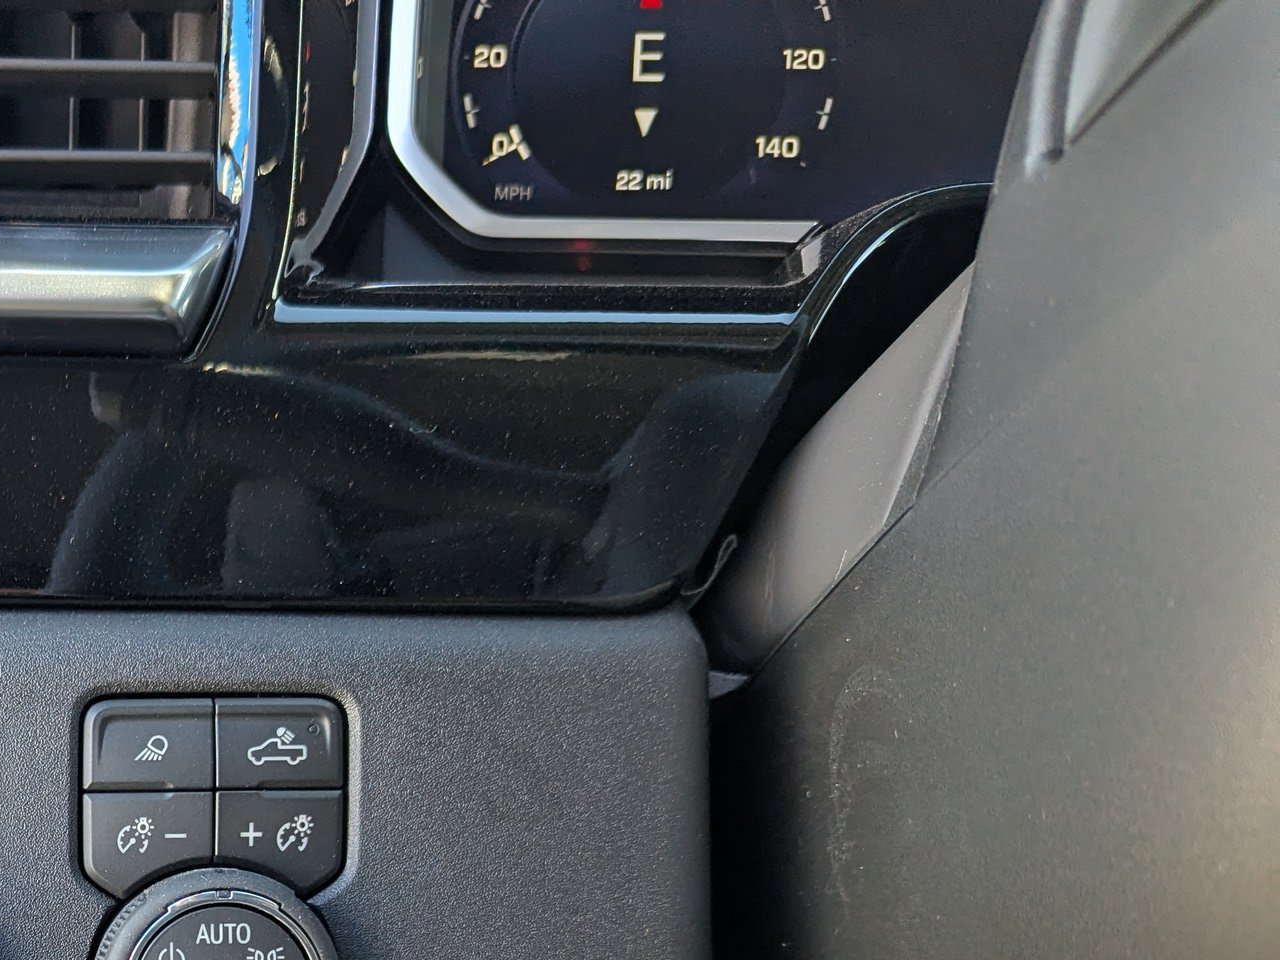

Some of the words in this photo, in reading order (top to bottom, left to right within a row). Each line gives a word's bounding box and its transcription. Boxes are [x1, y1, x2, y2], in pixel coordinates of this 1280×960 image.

[473, 44, 508, 69] 20
[632, 31, 666, 83] E
[783, 48, 826, 71] 120
[491, 132, 510, 158] 0
[755, 136, 801, 159] 140
[615, 170, 644, 191] 22
[645, 168, 674, 191] mi
[494, 185, 533, 201] MPH
[195, 922, 251, 945] AUTO
